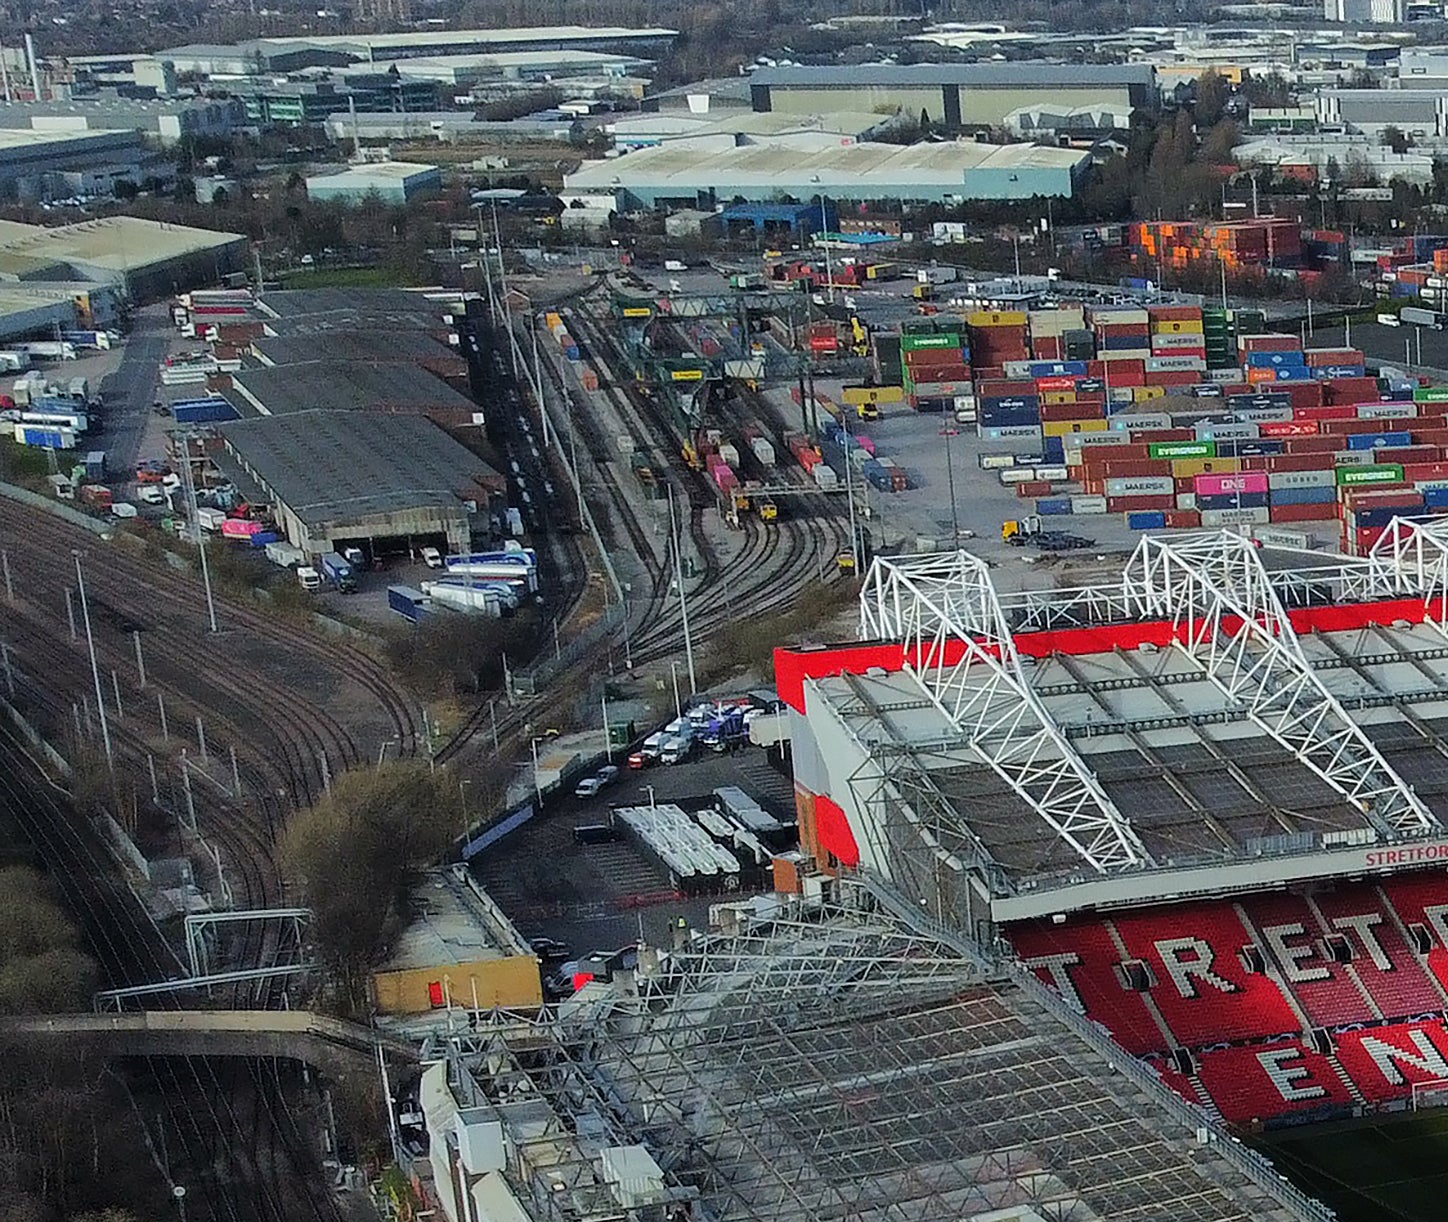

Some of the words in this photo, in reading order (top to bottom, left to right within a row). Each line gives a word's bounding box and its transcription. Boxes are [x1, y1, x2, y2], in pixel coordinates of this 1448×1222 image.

[1126, 420, 1163, 429] MAERSK
[1124, 482, 1165, 491] MAERSK
[1220, 478, 1246, 490] ONE
